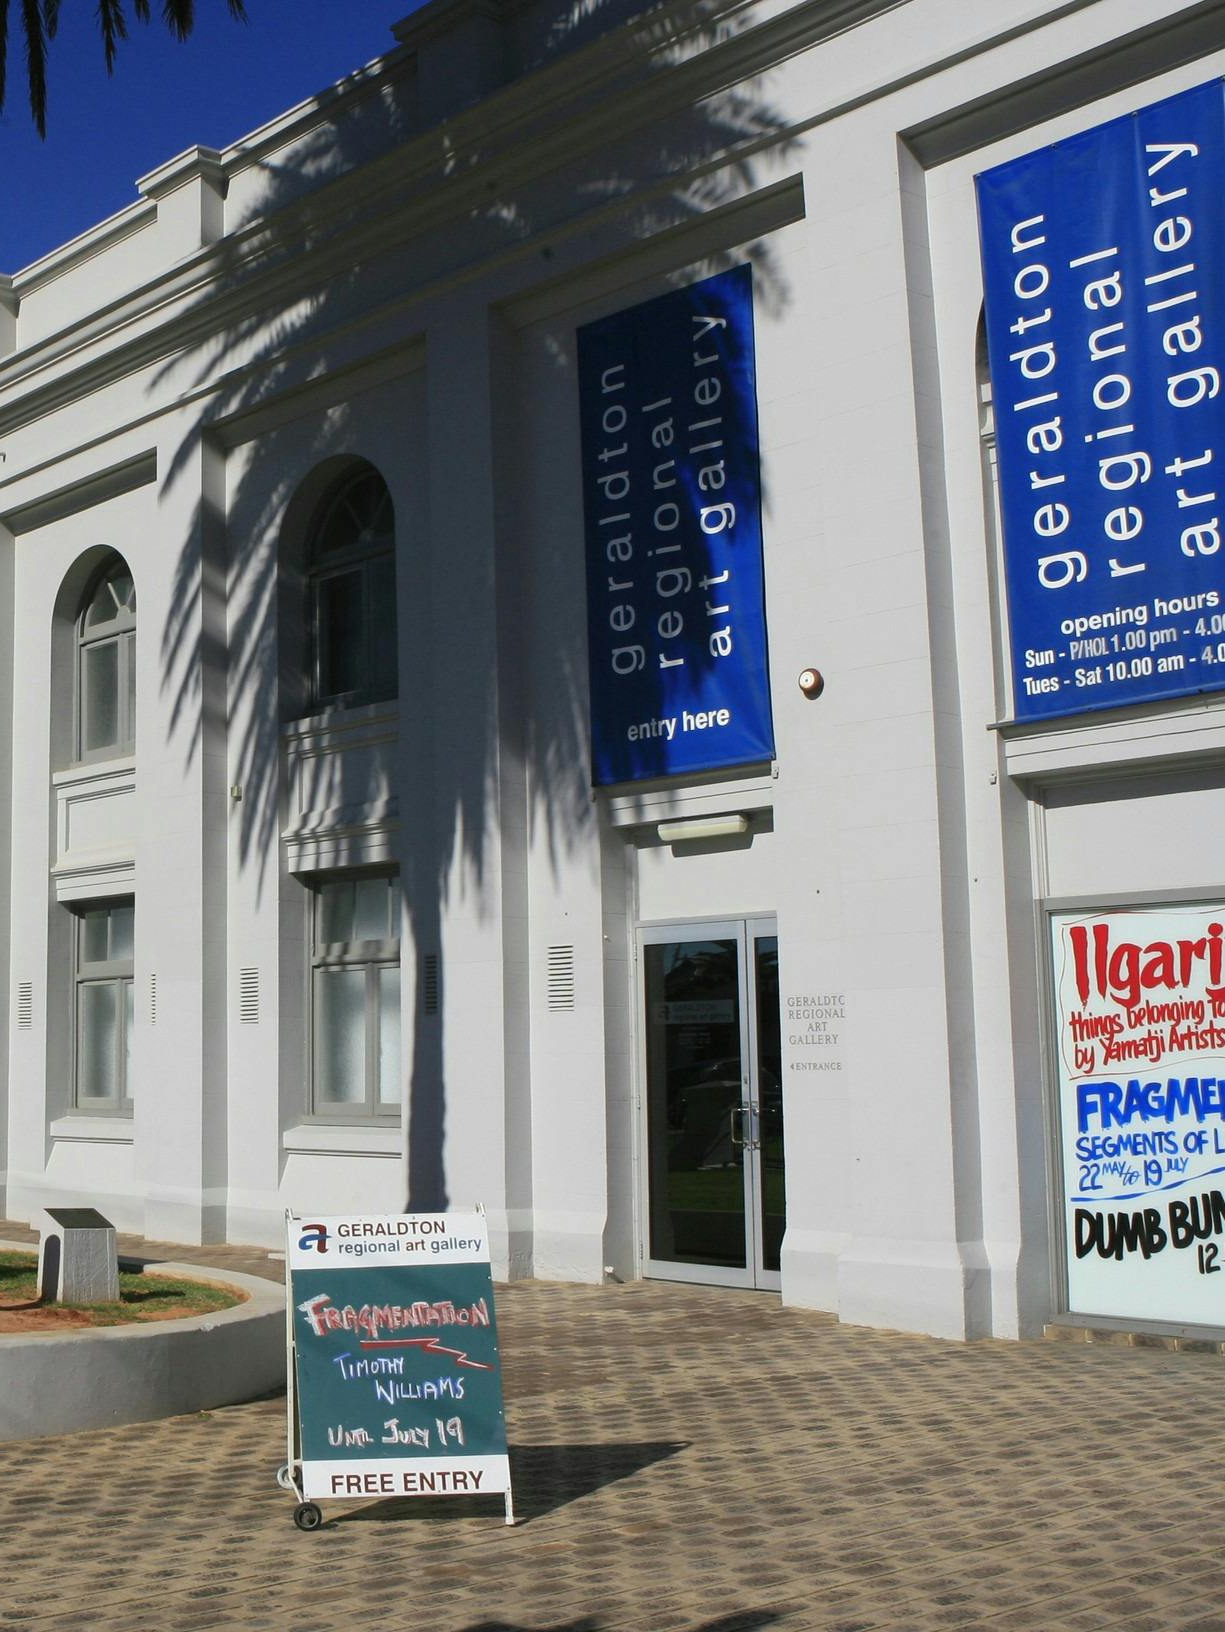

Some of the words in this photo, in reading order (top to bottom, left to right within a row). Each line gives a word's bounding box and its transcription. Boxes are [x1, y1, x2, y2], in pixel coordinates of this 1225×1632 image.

[1144, 143, 1221, 409] gallery
[1009, 214, 1088, 590] geraldton
[1069, 245, 1151, 580] regional
[689, 315, 736, 536] gallery
[598, 364, 646, 675] geraldton
[1165, 448, 1221, 559] art
[642, 397, 693, 671] regional
[698, 569, 733, 658] art
[1061, 607, 1148, 637] opening
[1153, 591, 1219, 617] hours
[1025, 649, 1054, 668] Sun
[1069, 637, 1109, 661] P/HOL
[1110, 629, 1147, 652] 1.00
[1149, 627, 1177, 651] pm
[1023, 677, 1059, 696] Tues
[1075, 666, 1102, 688] Sat
[1105, 656, 1153, 682] 10.00
[1157, 654, 1184, 673] am
[627, 715, 677, 743] entry
[681, 707, 730, 731] here
[1069, 923, 1225, 1011] Ilgari
[789, 1008, 845, 1020] REGIONAL
[808, 1022, 828, 1032] ART
[1069, 1010, 1124, 1042] things
[1127, 995, 1205, 1030] belonging
[789, 1034, 838, 1045] GALLERY
[1075, 1044, 1095, 1074] by
[1099, 1029, 1166, 1065] Yamatji
[1169, 1021, 1225, 1052] Artists
[796, 1062, 842, 1071] ENTRANCE
[1076, 1130, 1178, 1162] SEGMENTS
[1183, 1130, 1209, 1155] OF
[1079, 1163, 1103, 1191] 22
[1102, 1160, 1126, 1178] MAY
[1122, 1165, 1141, 1186] to
[1143, 1159, 1162, 1186] 19
[1164, 1157, 1189, 1173] JULY
[337, 1220, 446, 1237] GERALDTON
[338, 1240, 400, 1256] regional
[405, 1239, 426, 1252] art
[431, 1237, 482, 1253] gallery
[1075, 1208, 1167, 1261] DUMB
[1198, 1243, 1221, 1275] 12
[333, 1352, 407, 1379] TIMOTHY
[375, 1376, 464, 1405] WILLIAMS
[381, 1417, 430, 1449] JULY
[435, 1415, 464, 1447] 19
[331, 1474, 395, 1494] FREE
[403, 1471, 484, 1492] ENTRY
